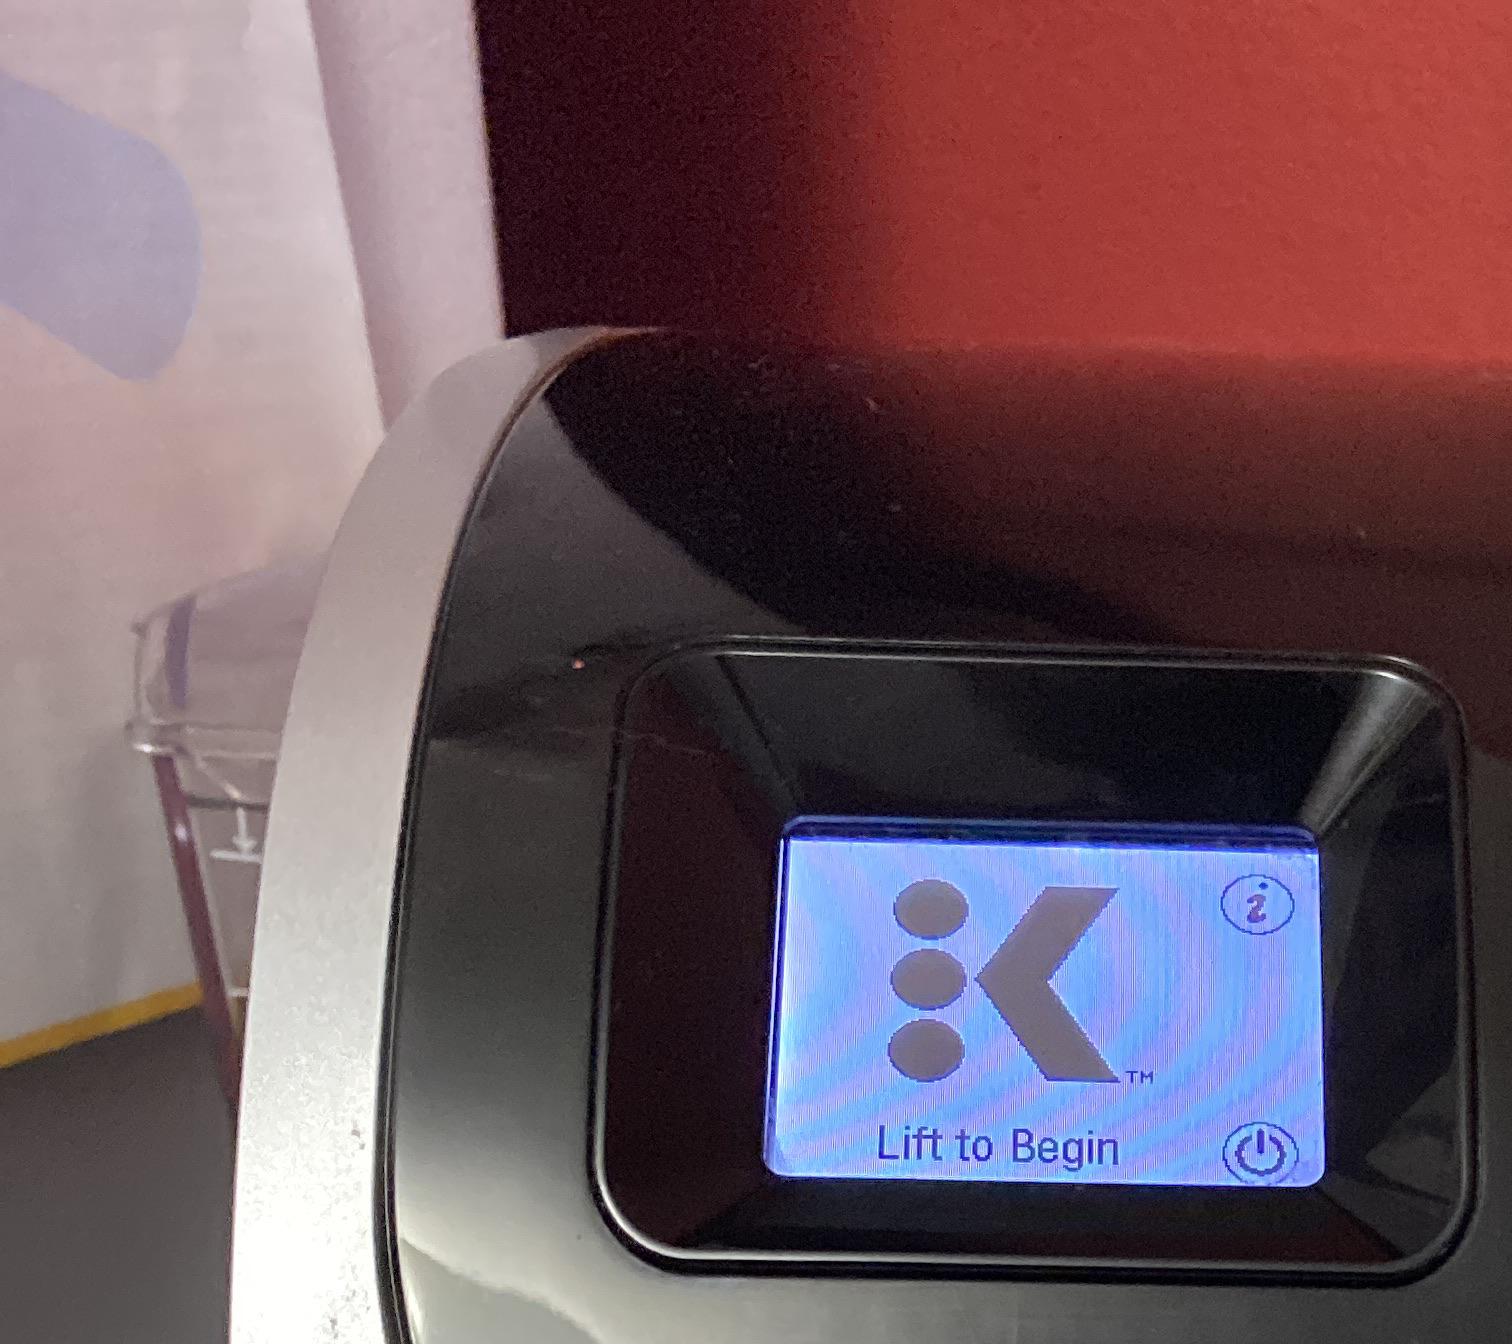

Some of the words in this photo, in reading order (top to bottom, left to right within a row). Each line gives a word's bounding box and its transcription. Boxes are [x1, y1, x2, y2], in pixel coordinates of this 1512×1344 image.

[876, 1125, 943, 1164] Lift
[955, 1128, 993, 1163] to
[1011, 1127, 1121, 1172] Begin
